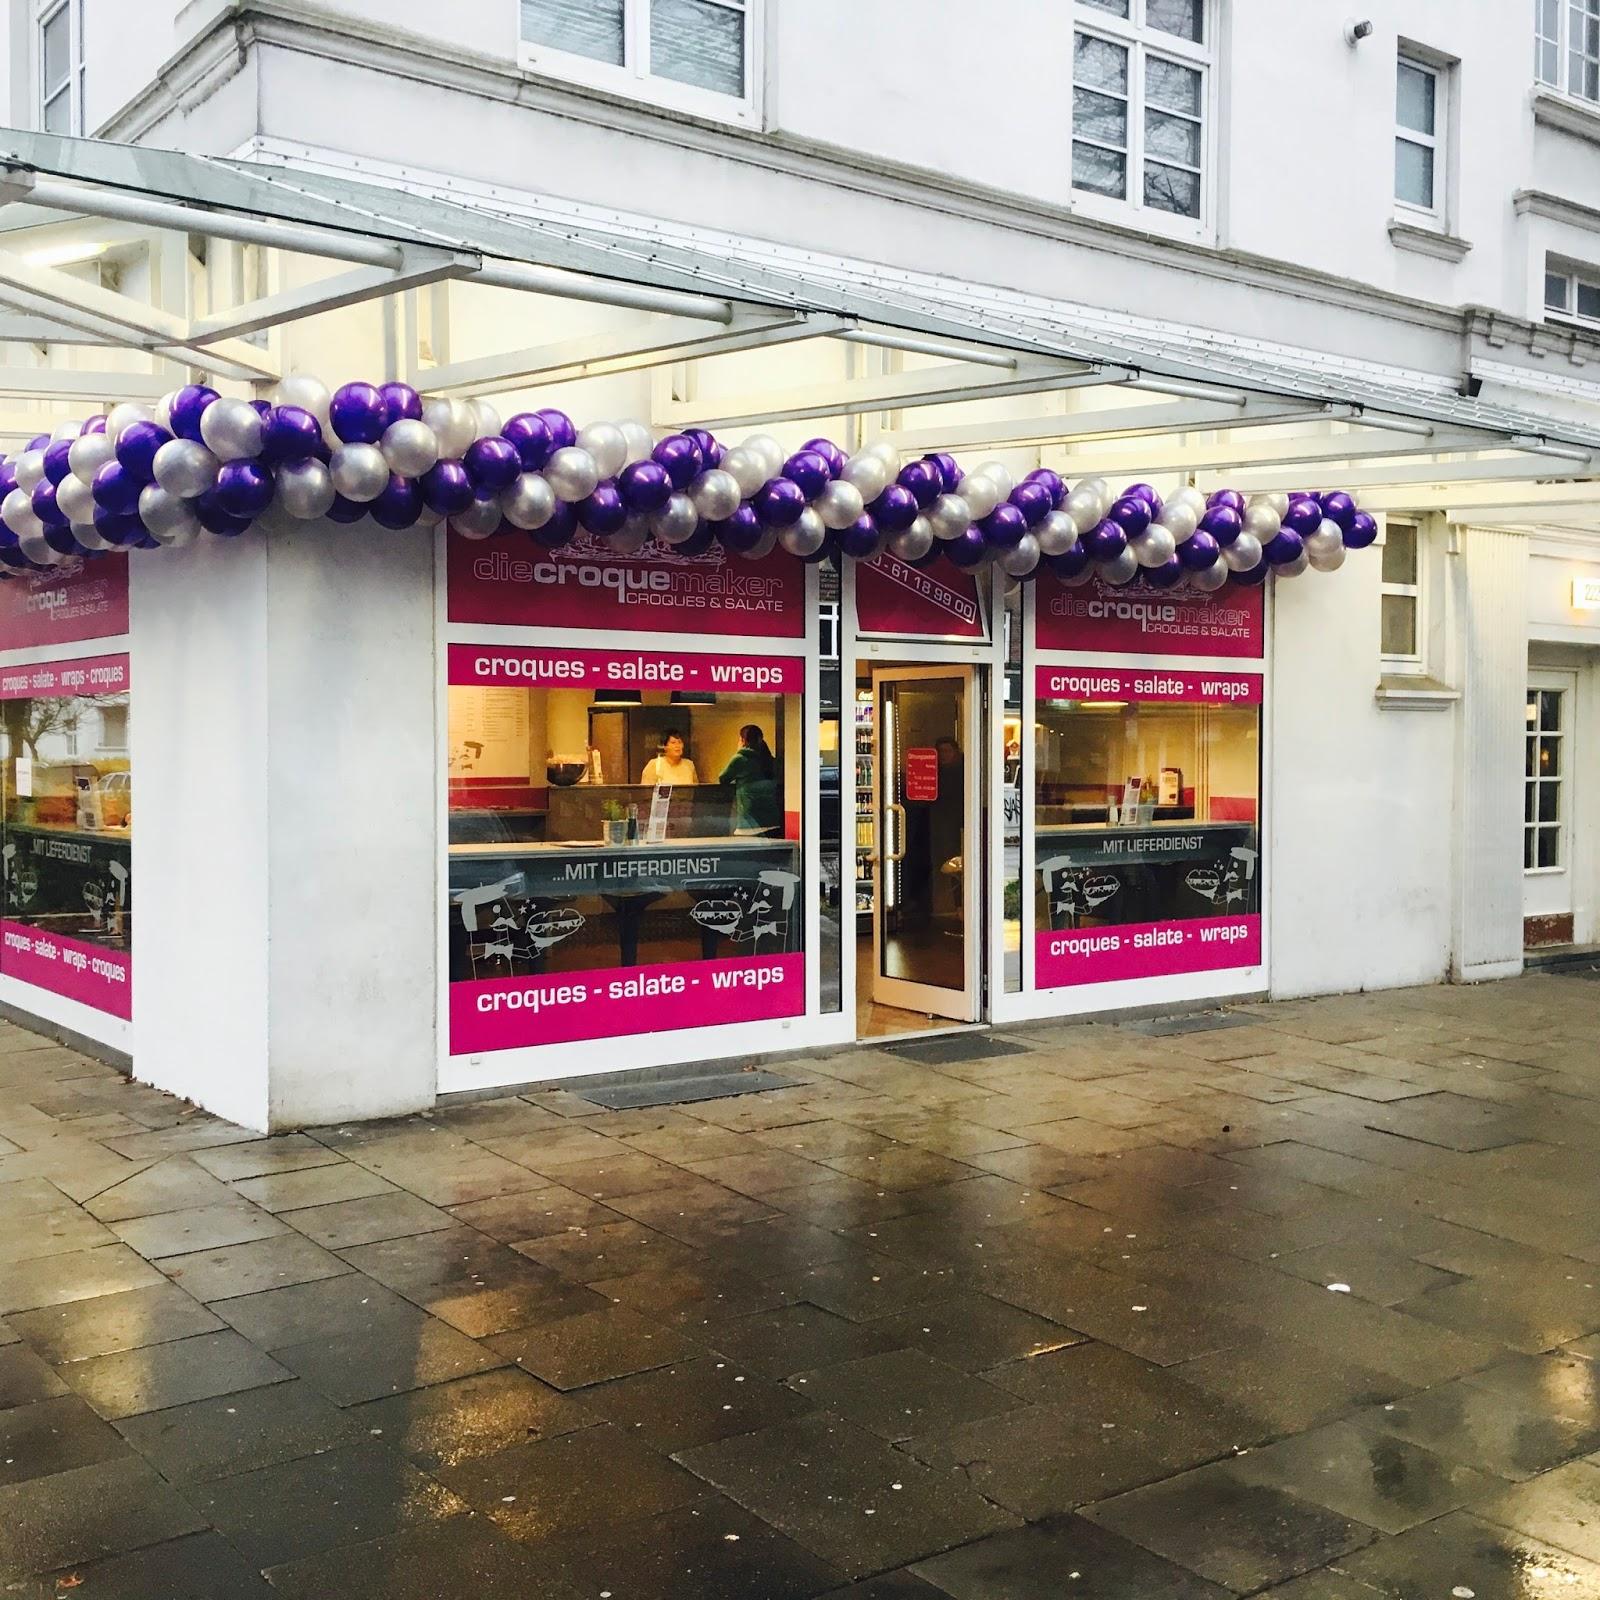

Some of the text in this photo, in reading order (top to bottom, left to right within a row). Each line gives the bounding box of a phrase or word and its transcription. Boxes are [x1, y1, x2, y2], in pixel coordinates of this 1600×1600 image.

[626, 592, 784, 612] CROQUES & SALATE
[891, 562, 909, 583] 61
[913, 575, 931, 595] 18
[933, 587, 952, 607] 99
[954, 599, 973, 618] 00
[1146, 623, 1251, 639] CROQUES & SALATE
[2, 675, 28, 695] croques
[32, 669, 55, 689] salate
[61, 669, 86, 691] wraps
[90, 665, 124, 688] croques
[474, 656, 585, 681] croques
[606, 656, 685, 681] salate
[710, 664, 784, 689] wraps
[1050, 675, 1121, 698] croques
[1134, 675, 1184, 695] salate
[1200, 680, 1250, 700] wraps
[1127, 836, 1204, 853] LIEFERDIENST
[603, 857, 721, 879] LIEFERDIENST
[1050, 935, 1121, 958] croques
[1134, 927, 1184, 948] salate
[1200, 924, 1249, 944] wraps
[5, 931, 31, 954] croques
[35, 936, 57, 960] salate
[63, 947, 87, 972] wraps
[92, 957, 126, 984] croques
[477, 983, 587, 1013] croques
[608, 973, 686, 1000] salate
[711, 965, 784, 992] wraps
